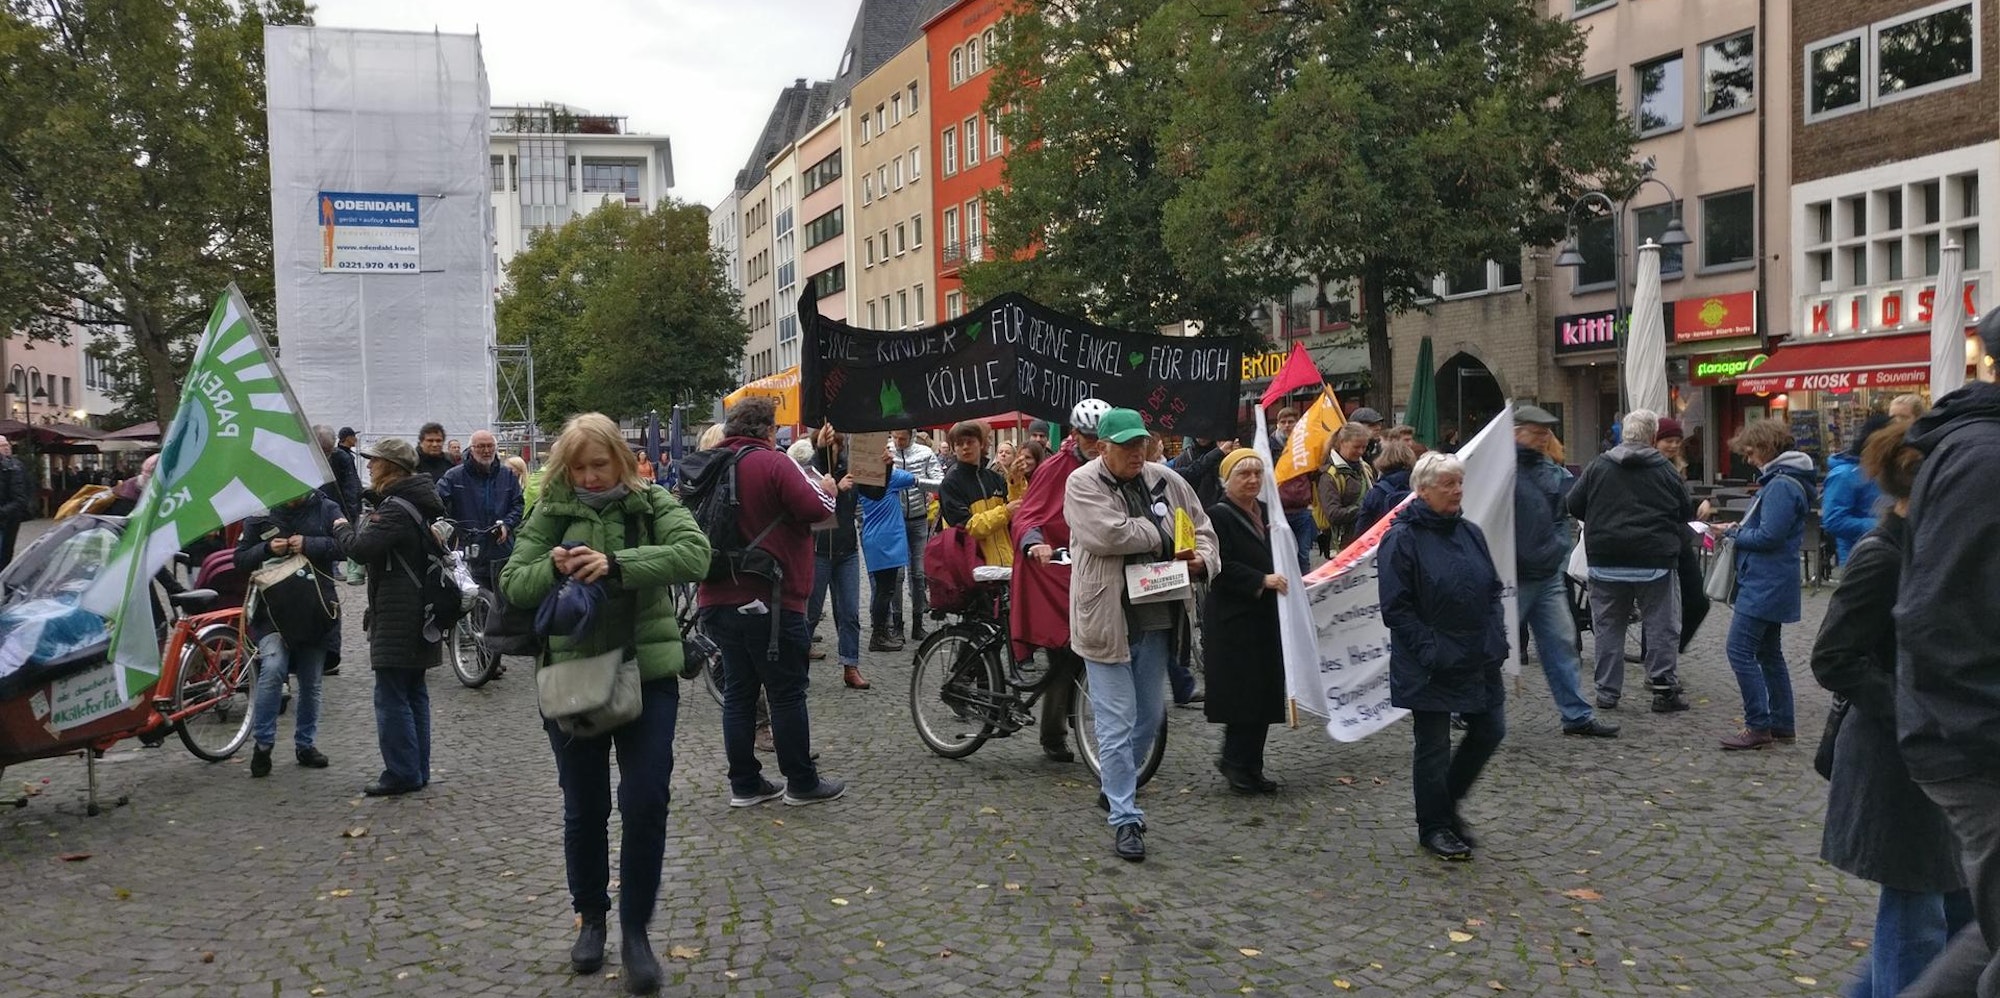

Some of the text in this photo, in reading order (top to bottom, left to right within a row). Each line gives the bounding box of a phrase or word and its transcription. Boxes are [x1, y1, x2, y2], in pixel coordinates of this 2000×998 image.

[333, 200, 415, 212] ODENDAHL
[338, 261, 384, 269] 0221.970
[1812, 284, 1977, 334] KIOSK
[1562, 314, 1614, 345] kitti
[877, 328, 957, 362] KINDER
[990, 303, 1025, 345] FÜR
[1028, 316, 1073, 364] DEINE
[1076, 333, 1122, 377] ENKEL
[1148, 345, 1182, 381] FÜR
[1190, 348, 1230, 382] DICH
[925, 360, 1005, 409] KÖLLE
[1016, 357, 1038, 398] FOR
[1751, 384, 1766, 392] ATM
[1802, 373, 1851, 389] KIOSK
[1876, 371, 1926, 384] Souvenirs
[53, 688, 123, 724] #KölleForFut
